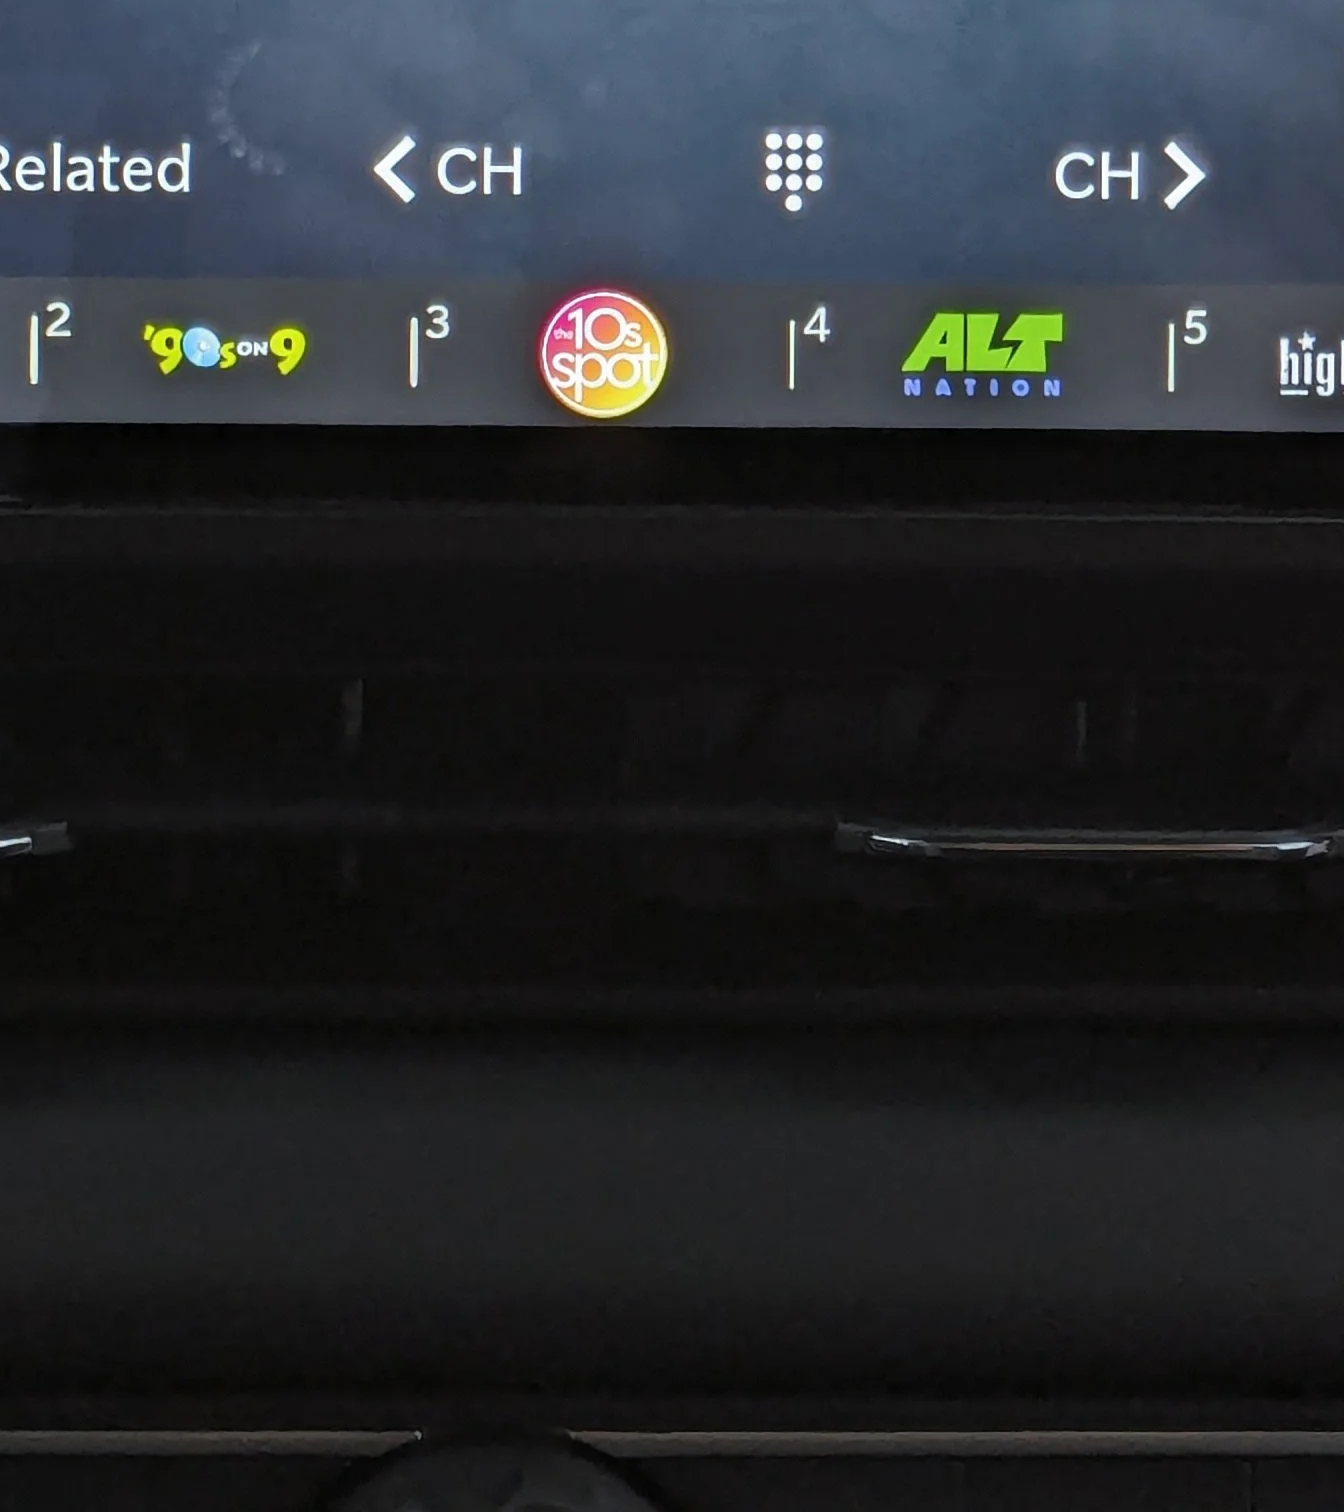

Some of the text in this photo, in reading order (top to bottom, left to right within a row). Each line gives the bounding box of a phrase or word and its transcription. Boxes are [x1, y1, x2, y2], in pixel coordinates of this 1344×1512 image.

[436, 147, 523, 196] CH
[1054, 151, 1141, 201] CH
[44, 303, 72, 338] 2
[425, 305, 451, 340] 3
[802, 307, 832, 343] 4
[1182, 309, 1209, 345] 5
[901, 311, 1064, 373] ALT
[552, 341, 659, 404] spot
[903, 377, 1062, 398] NATION
